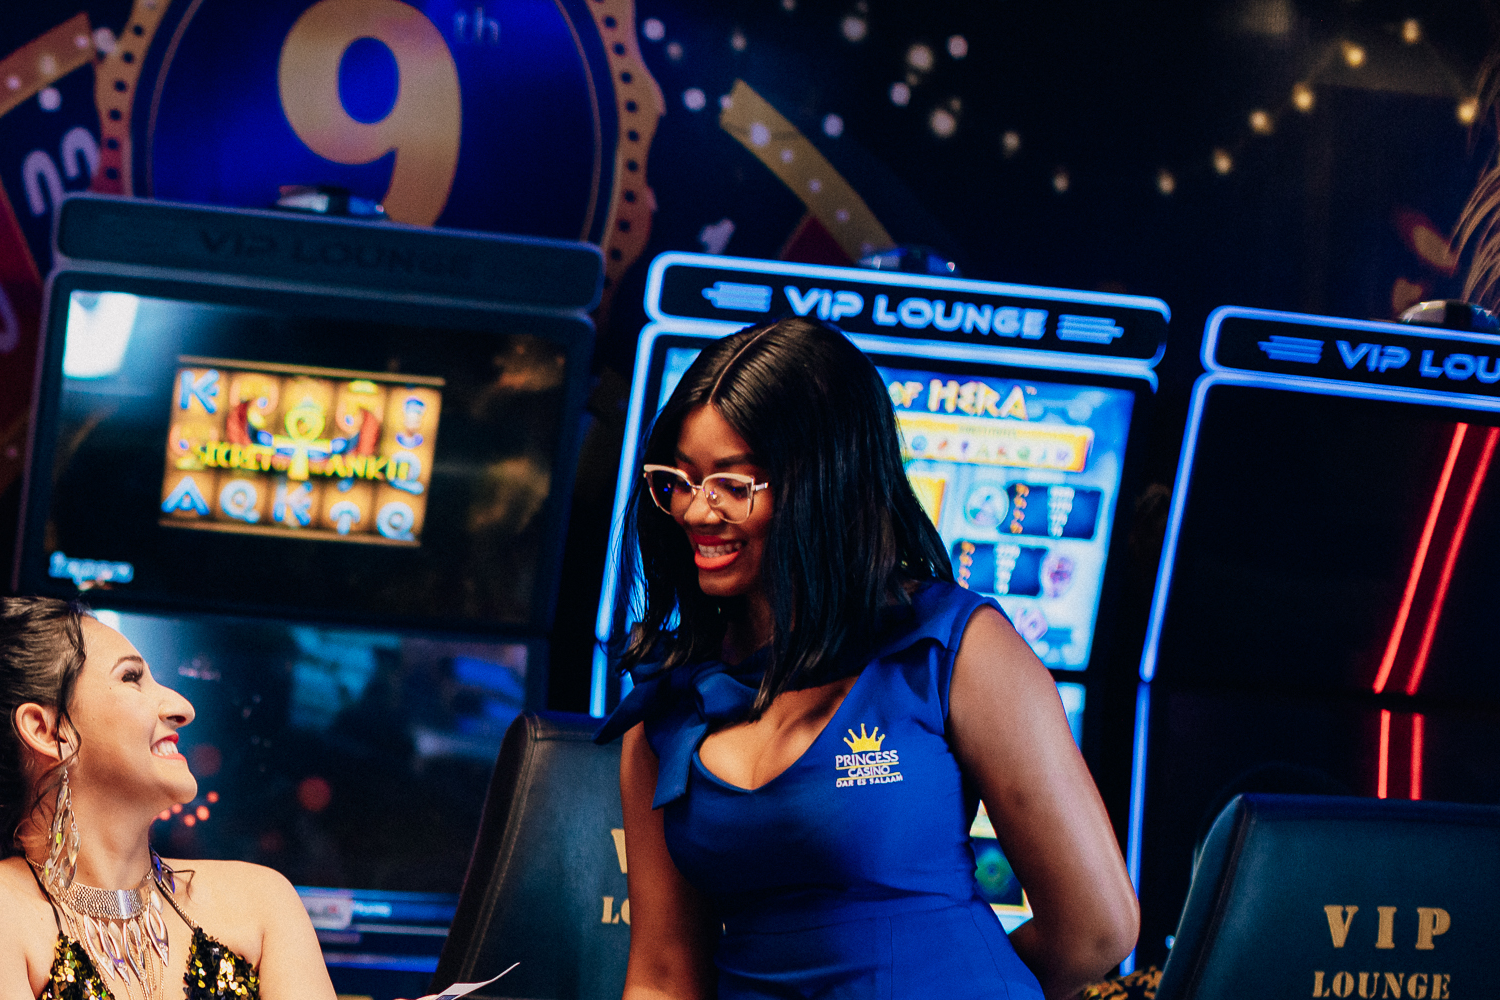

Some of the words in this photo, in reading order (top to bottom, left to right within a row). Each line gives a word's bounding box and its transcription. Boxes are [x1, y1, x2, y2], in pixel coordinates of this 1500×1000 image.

[200, 228, 277, 256] VIP
[784, 285, 864, 321] VIP
[872, 294, 1049, 340] LOUNGE
[1335, 340, 1411, 373] VIP
[927, 378, 1029, 421] HERA
[835, 750, 899, 767] PRINCESS
[848, 765, 890, 777] CASINO
[857, 778, 867, 786] ES
[869, 773, 903, 784] SALAAM
[1324, 905, 1451, 950] VIP
[1312, 971, 1451, 1000] LOUNGE
